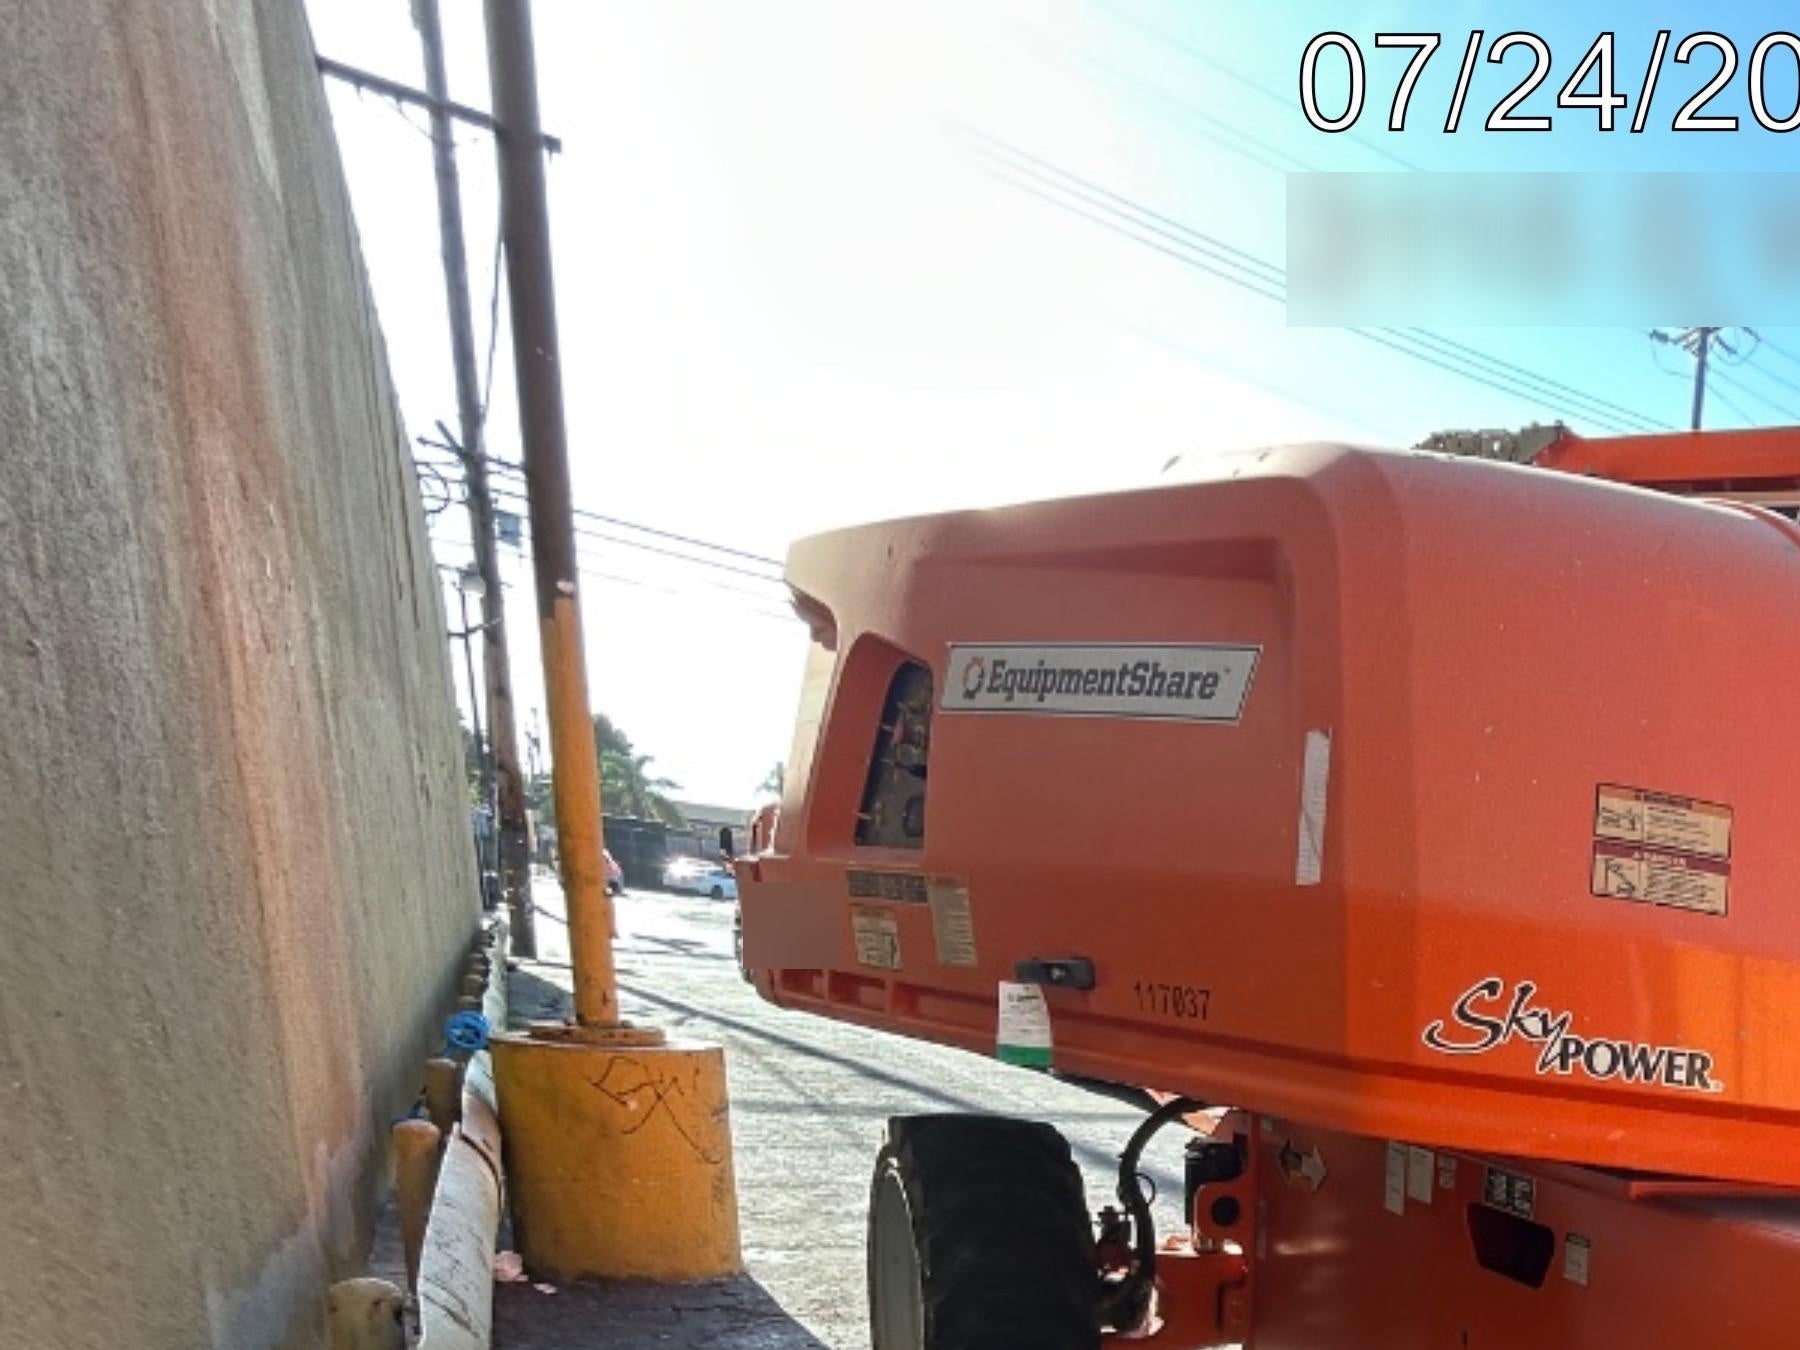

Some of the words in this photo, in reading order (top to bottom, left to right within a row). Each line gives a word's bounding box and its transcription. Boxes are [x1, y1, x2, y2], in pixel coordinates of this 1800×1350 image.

[986, 660, 1220, 702] EquipmentShare
[1133, 979, 1211, 1021] 117037
[1422, 977, 1572, 1074] Sky
[1557, 1036, 1712, 1090] POWER
